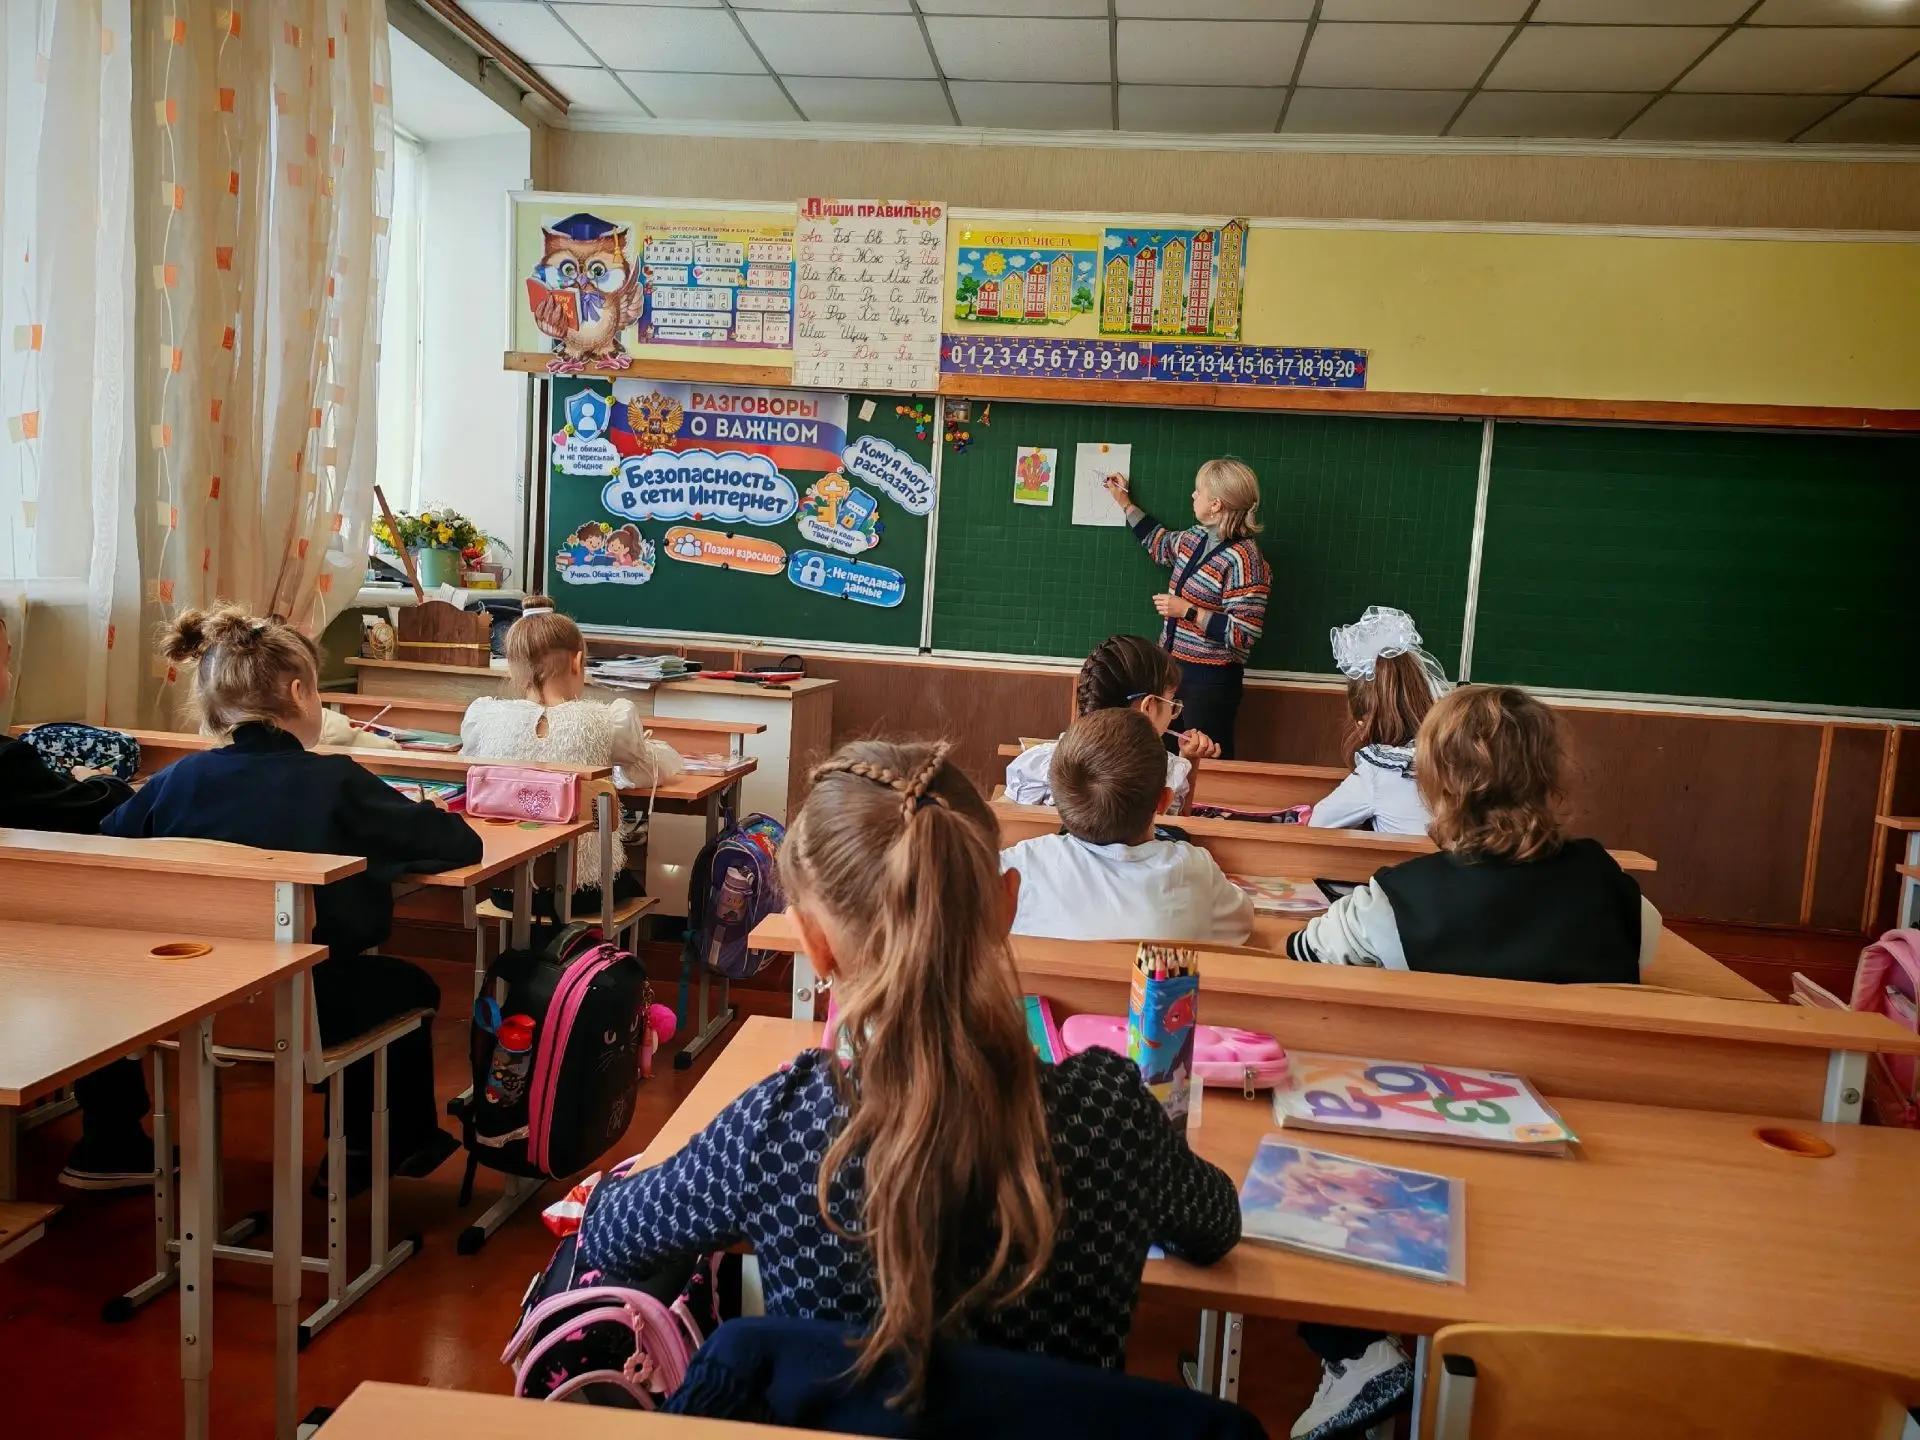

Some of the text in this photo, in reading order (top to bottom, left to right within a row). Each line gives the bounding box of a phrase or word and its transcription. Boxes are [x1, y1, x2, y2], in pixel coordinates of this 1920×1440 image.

[808, 198, 942, 219] ПИШИ ПРАВИЛЬНО
[984, 235, 1072, 247] СОСТАВ ЧИСЛА
[951, 346, 1139, 371] 0 1 2 3 4 5 6 7 8 9 10
[1161, 354, 1355, 378] 11 12 13 14 15 16 17 18 19 20
[691, 392, 818, 417] РАЗГОВОРЫ
[690, 416, 818, 444] О ВАЖНОМ
[567, 444, 607, 453] Не обижай
[578, 453, 615, 462] пересылай
[573, 462, 603, 470] обидное
[625, 465, 776, 491] Безопасность
[860, 441, 930, 493] Кому я могу
[853, 456, 928, 507] рассказать?
[621, 485, 788, 514] в сети Интернет
[833, 566, 900, 592] Не передавай
[843, 582, 883, 599] данные
